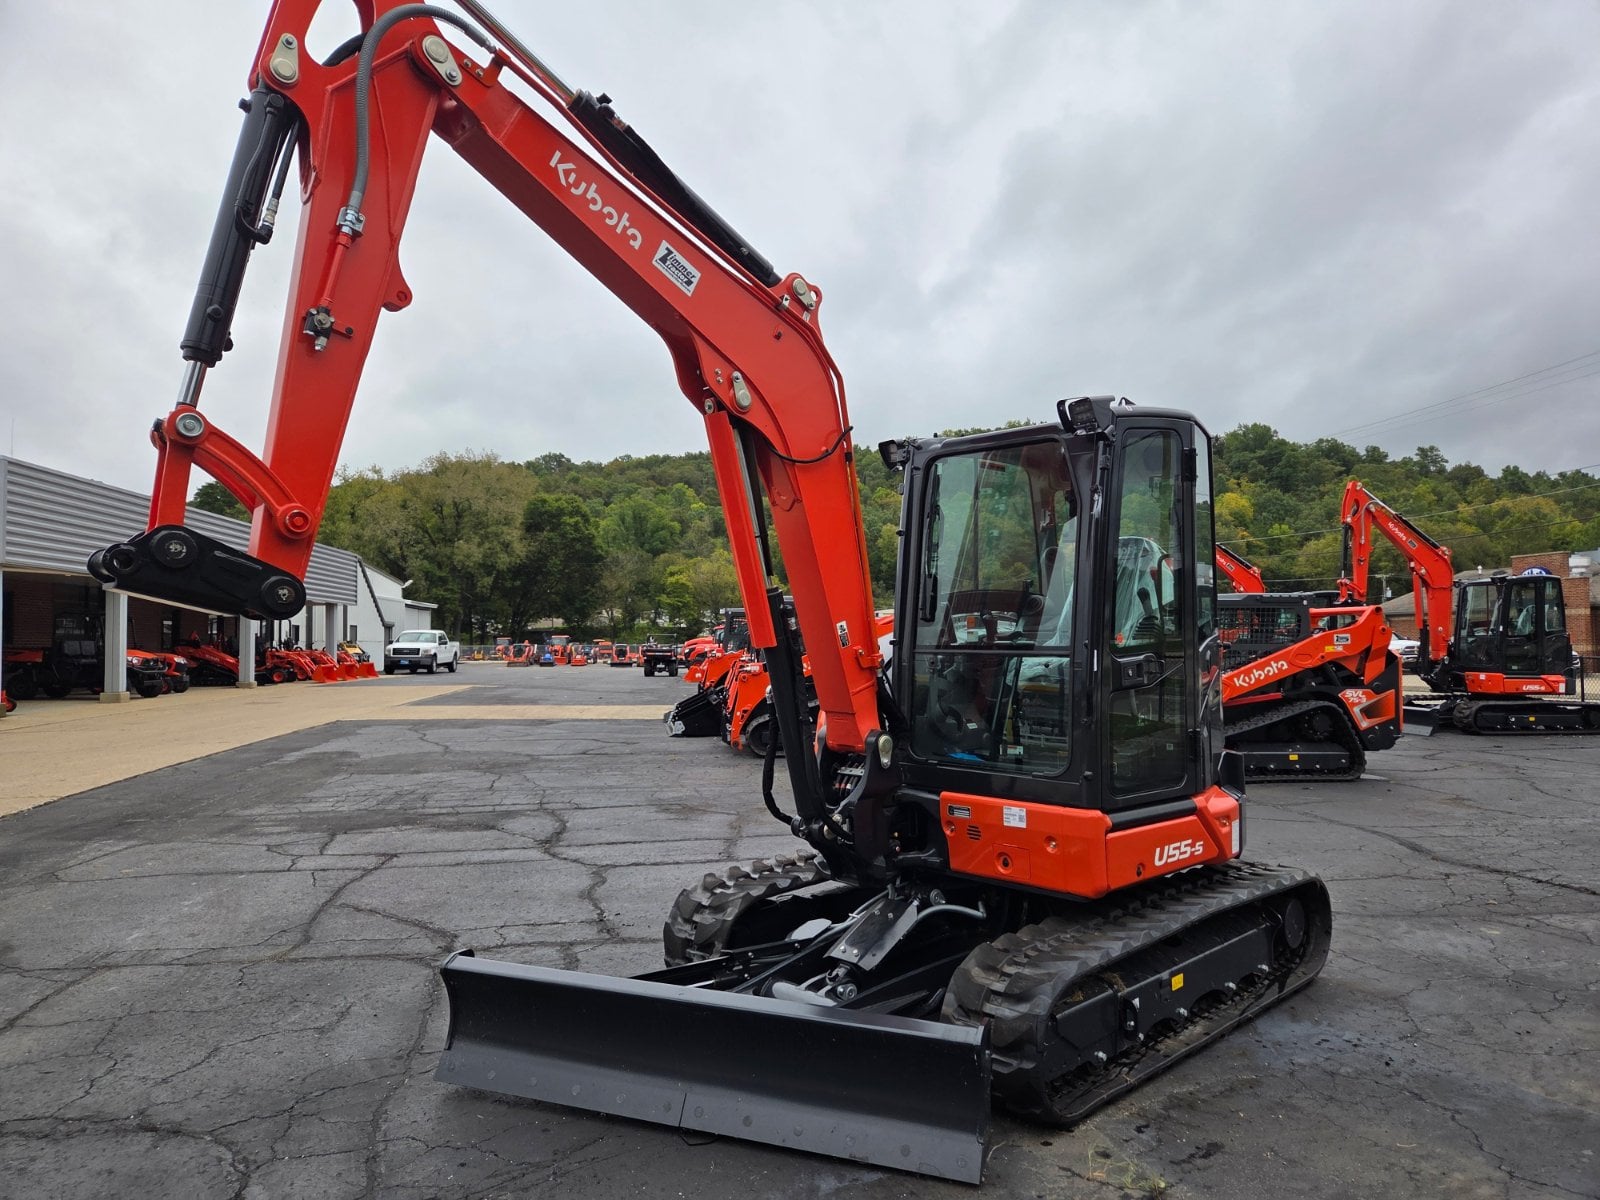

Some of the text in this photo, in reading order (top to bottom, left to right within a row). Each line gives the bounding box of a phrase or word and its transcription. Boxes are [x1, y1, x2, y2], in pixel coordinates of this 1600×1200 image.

[549, 150, 642, 250] Kubota
[658, 246, 697, 282] Zimmer
[1233, 660, 1289, 687] Kubota
[1344, 689, 1366, 698] SVL
